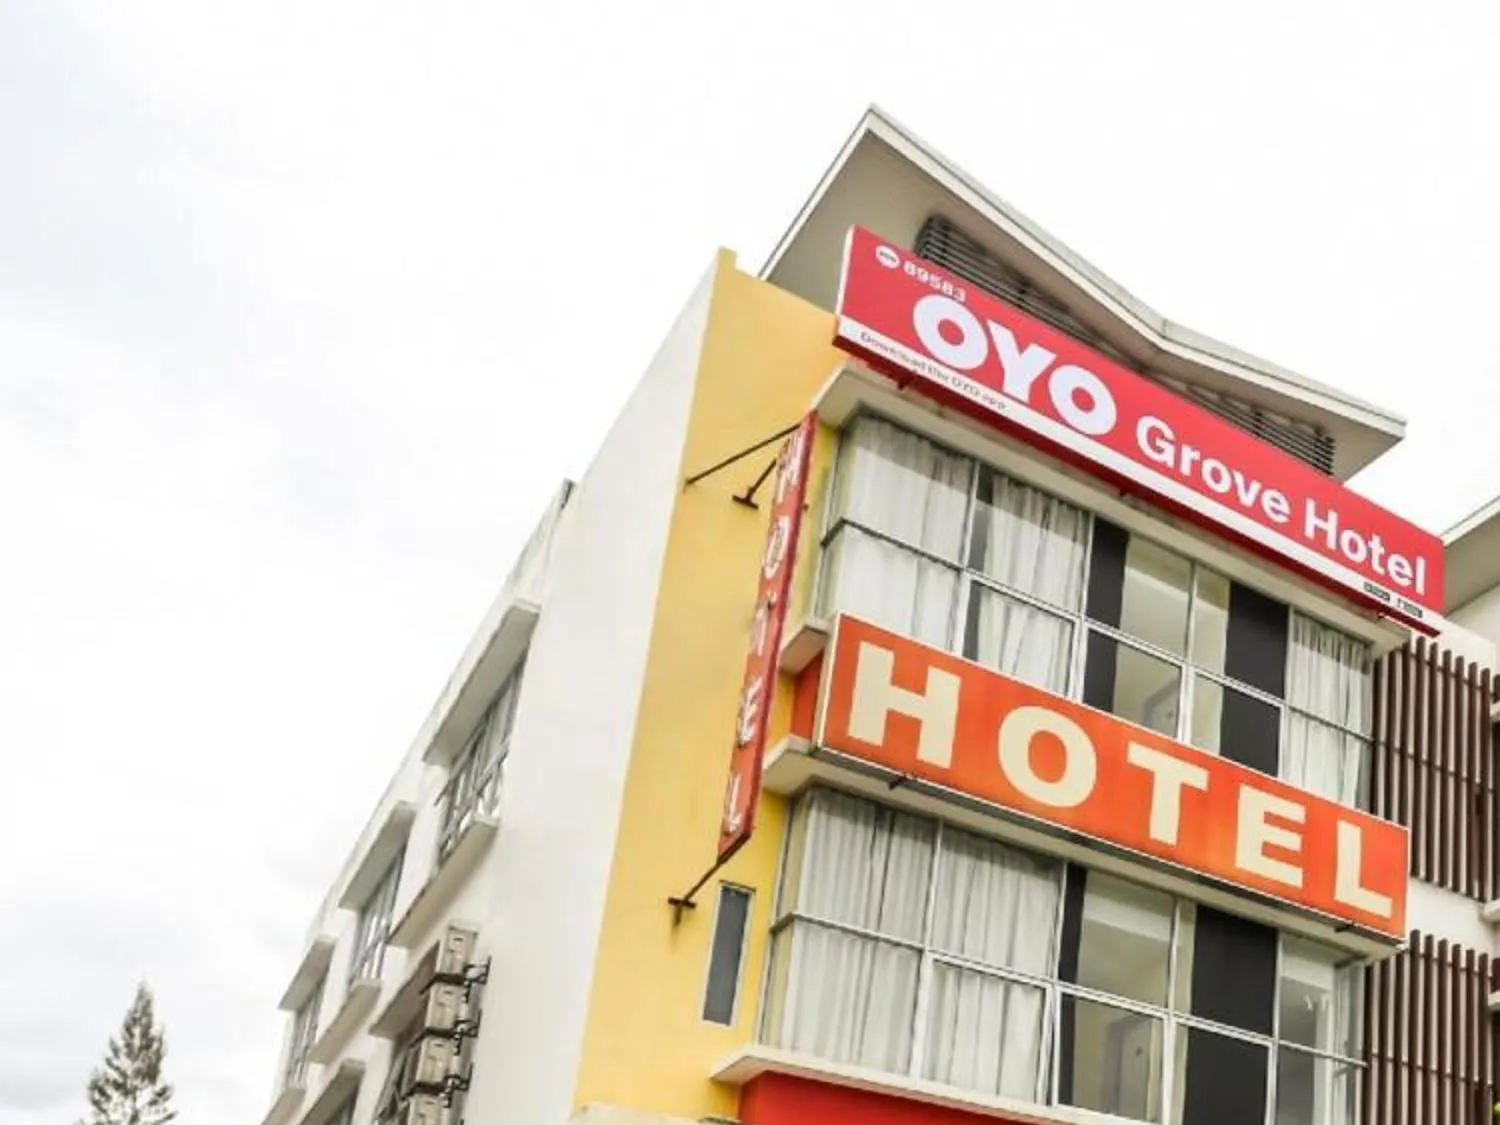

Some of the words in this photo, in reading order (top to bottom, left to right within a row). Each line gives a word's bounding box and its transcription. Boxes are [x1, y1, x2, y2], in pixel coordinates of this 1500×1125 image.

[912, 293, 1118, 437] OYO
[1134, 413, 1291, 525] Grove
[1303, 498, 1427, 597] Hotel
[722, 430, 806, 838] HOTEL
[844, 638, 1395, 921] HOTEL
